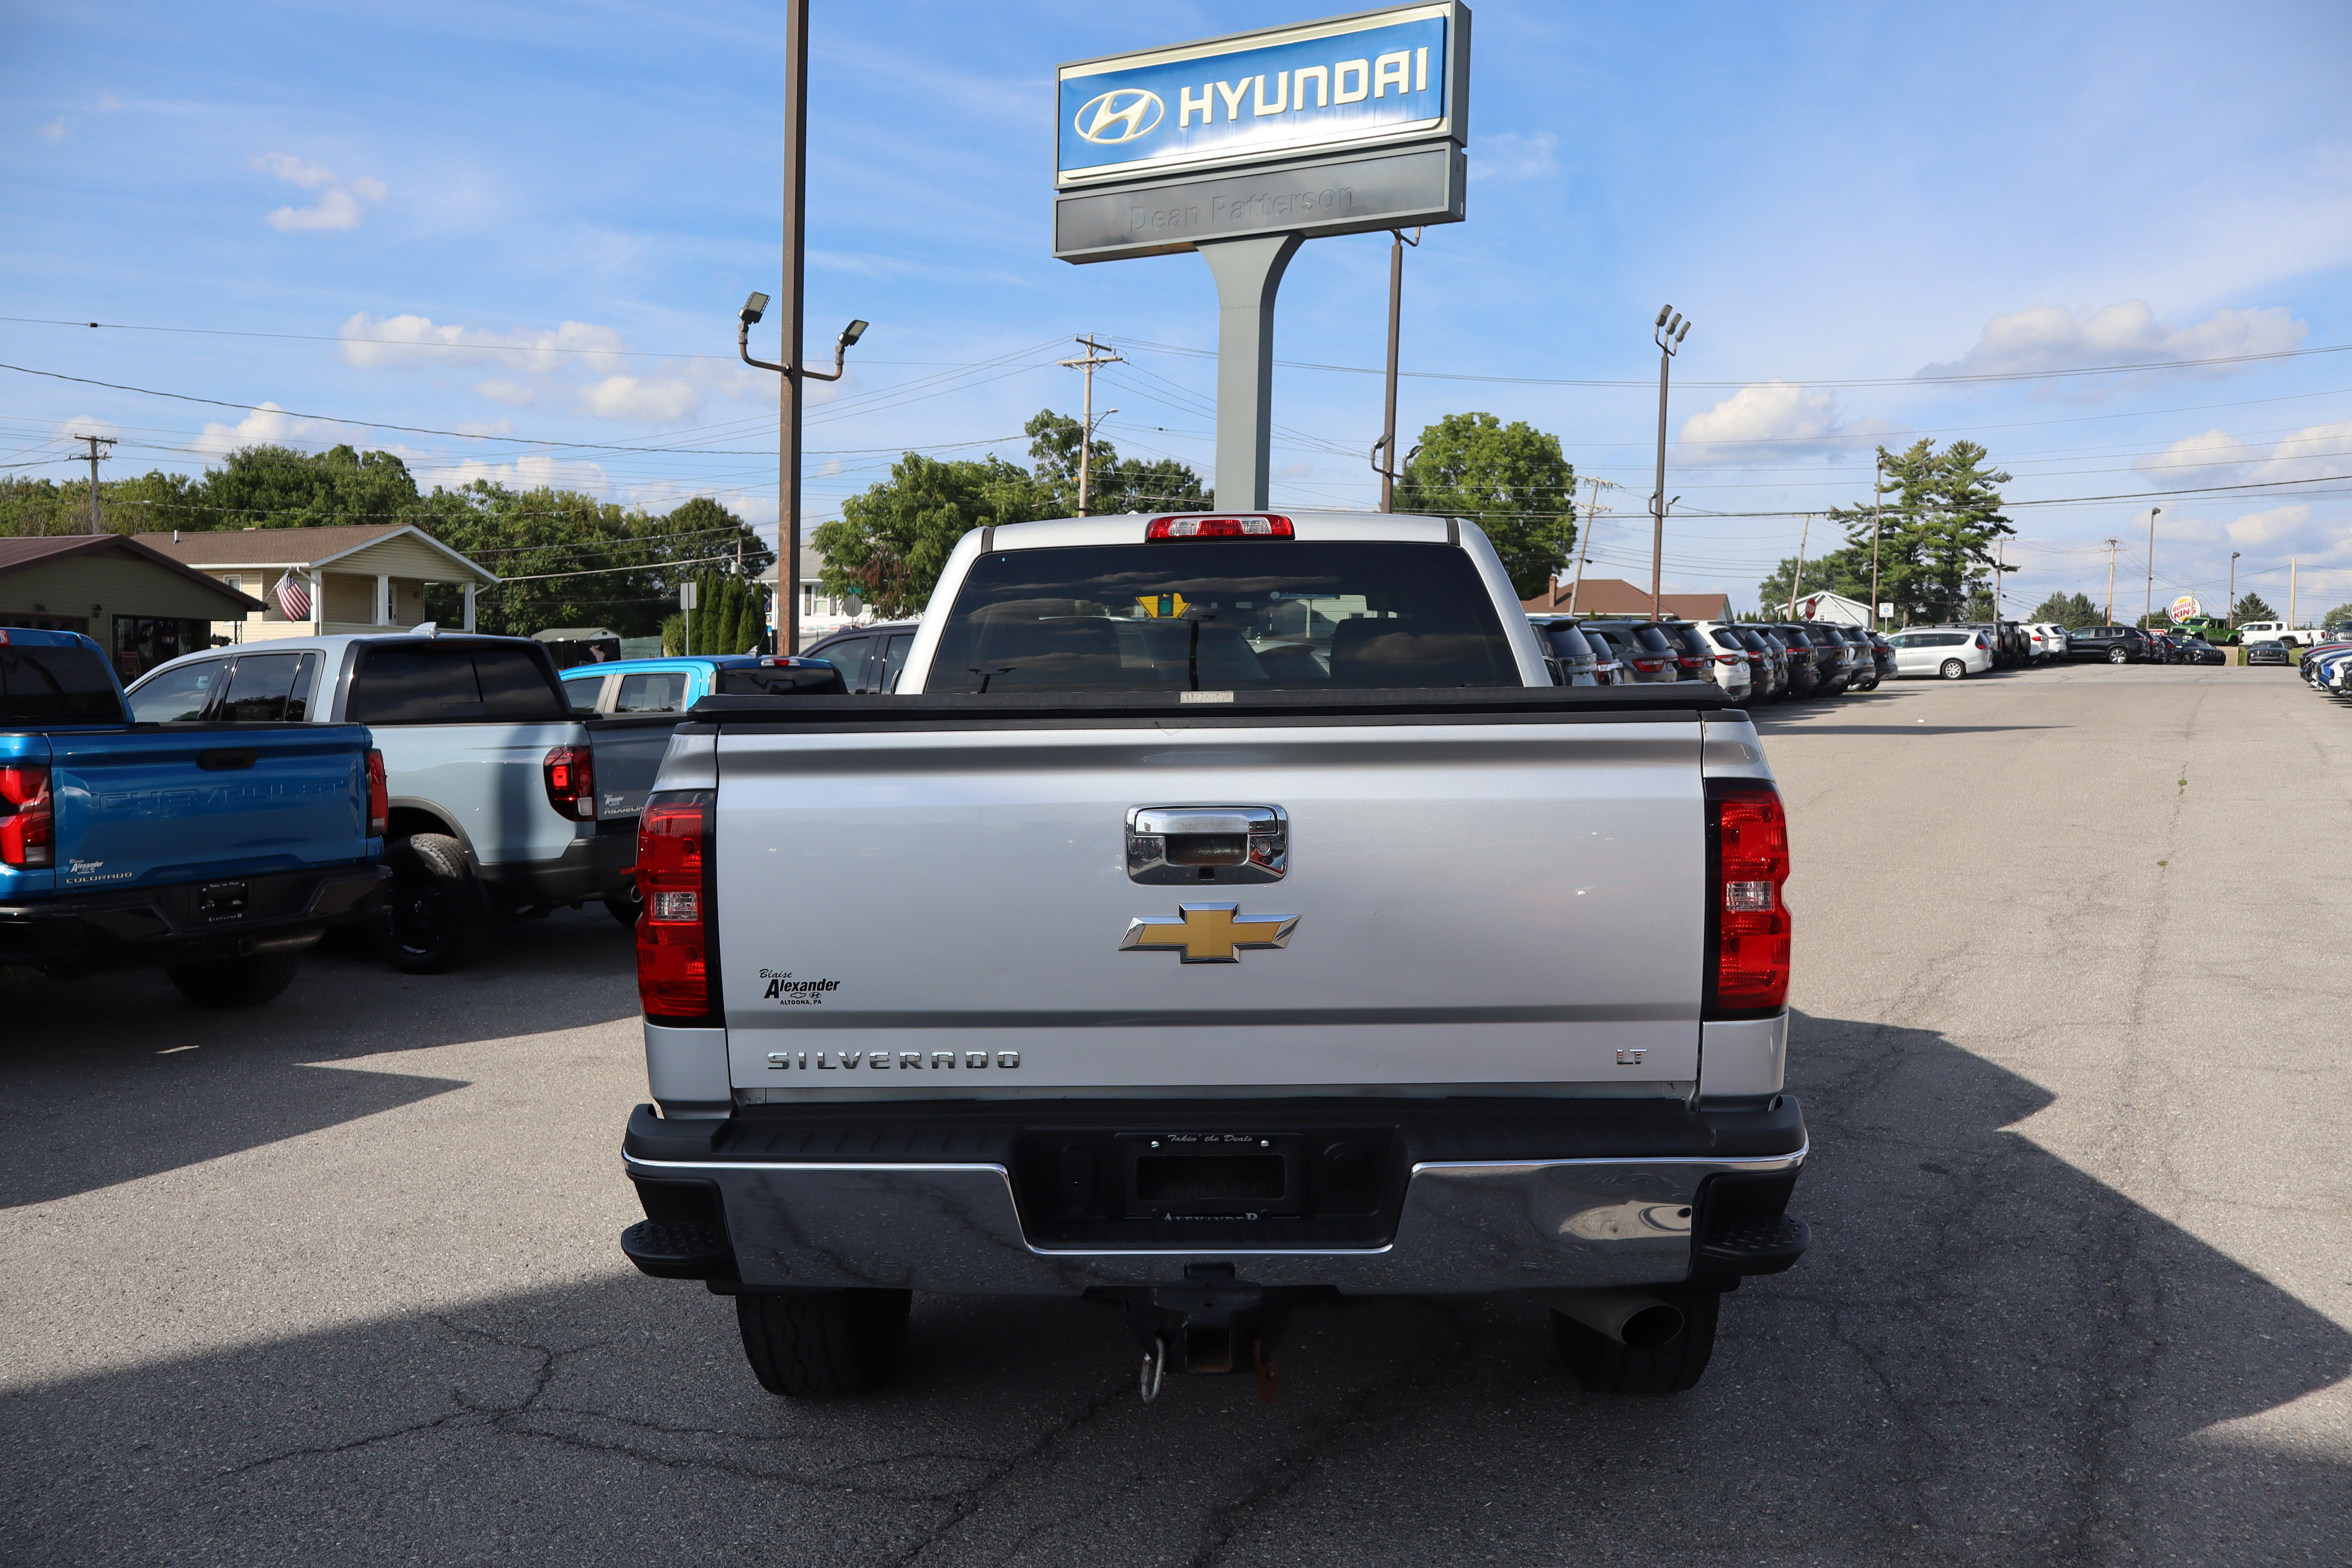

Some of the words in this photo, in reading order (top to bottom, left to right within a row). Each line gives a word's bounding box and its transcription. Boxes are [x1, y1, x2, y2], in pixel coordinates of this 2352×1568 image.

[1180, 47, 1428, 127] HYUNDAI
[1131, 206, 1200, 233] Dean
[1212, 186, 1355, 223] Patterson
[1806, 604, 1815, 614] STOP
[2173, 601, 2196, 612] BURGER
[2174, 607, 2196, 619] KING
[99, 780, 343, 811] CHEVROLET
[604, 805, 644, 815] RIDGELIN
[70, 861, 104, 873] Alexander
[66, 872, 133, 884] COLORADO
[759, 969, 793, 978] Blaise
[764, 978, 840, 999] Alexander
[767, 1051, 1020, 1069] SILVERADO
[1617, 1048, 1647, 1065] LT
